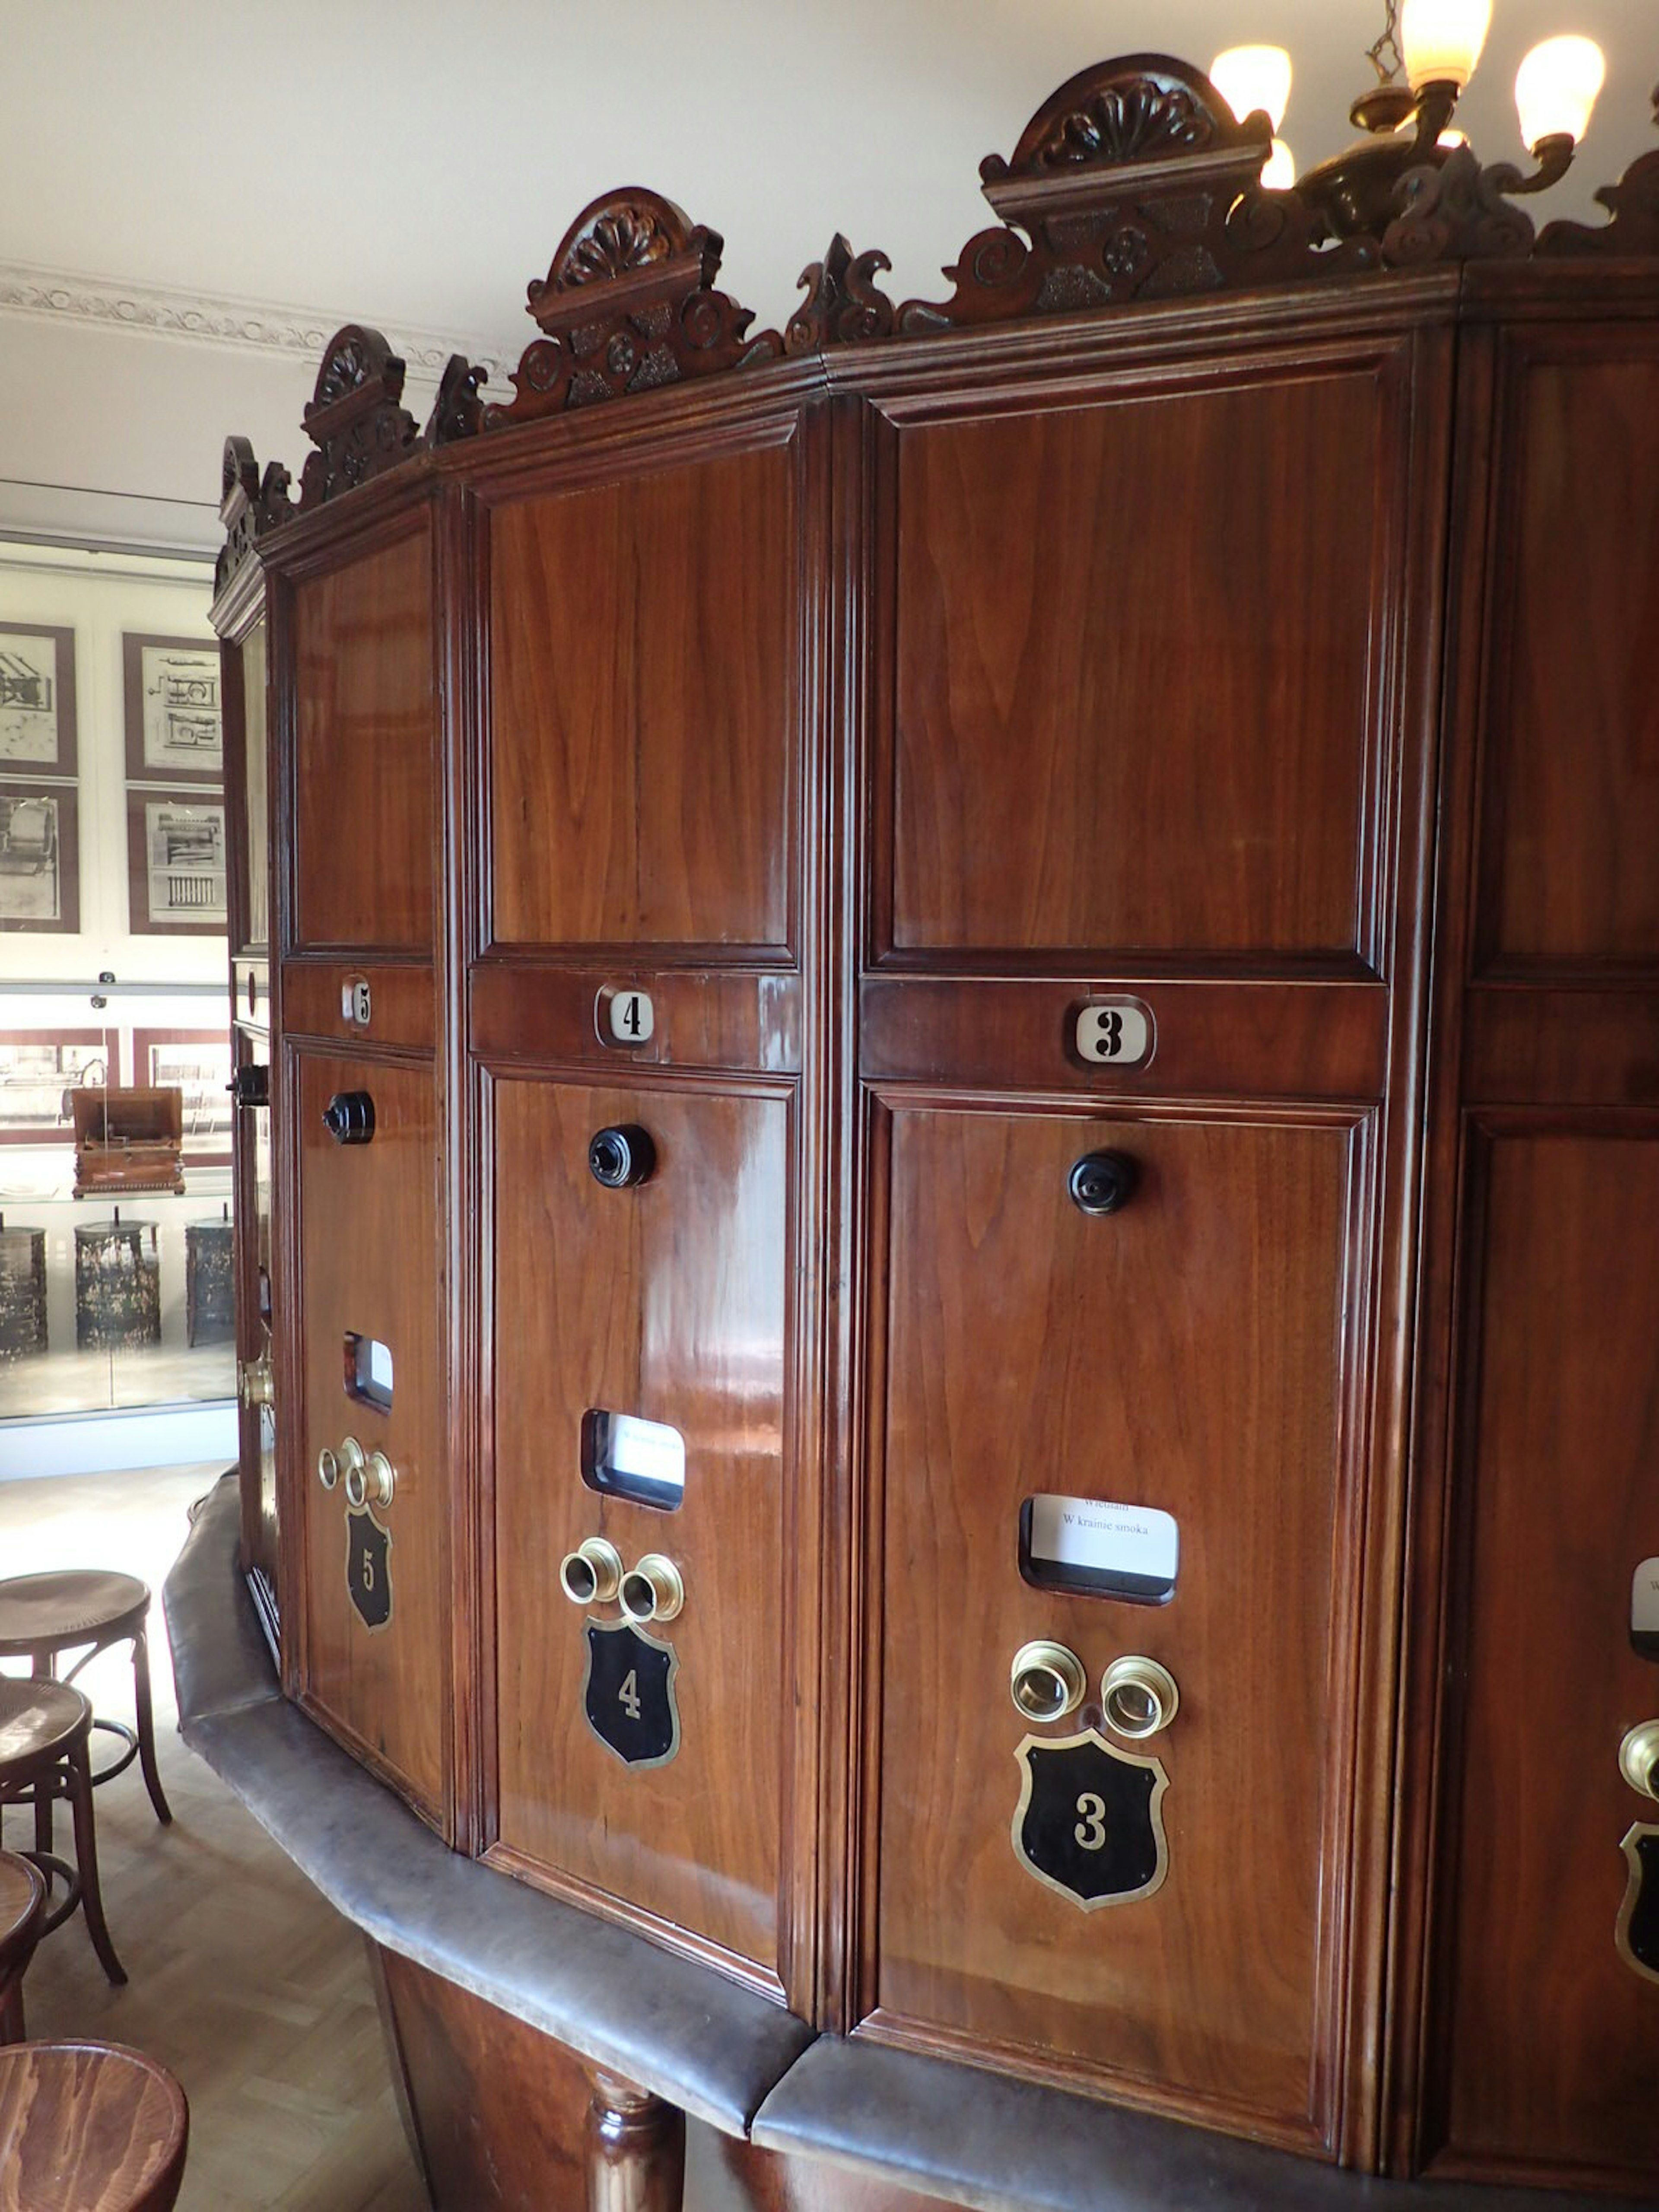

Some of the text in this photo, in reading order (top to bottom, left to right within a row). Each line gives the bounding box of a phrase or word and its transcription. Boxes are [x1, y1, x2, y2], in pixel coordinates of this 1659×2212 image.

[361, 988, 368, 1019] 5
[624, 997, 640, 1035] 4
[1096, 1011, 1122, 1056] 3
[1063, 1513, 1148, 1535] W krainie smoka
[363, 1548, 374, 1592] 5
[619, 1669, 641, 1719] 4
[1074, 1792, 1106, 1850] 3
